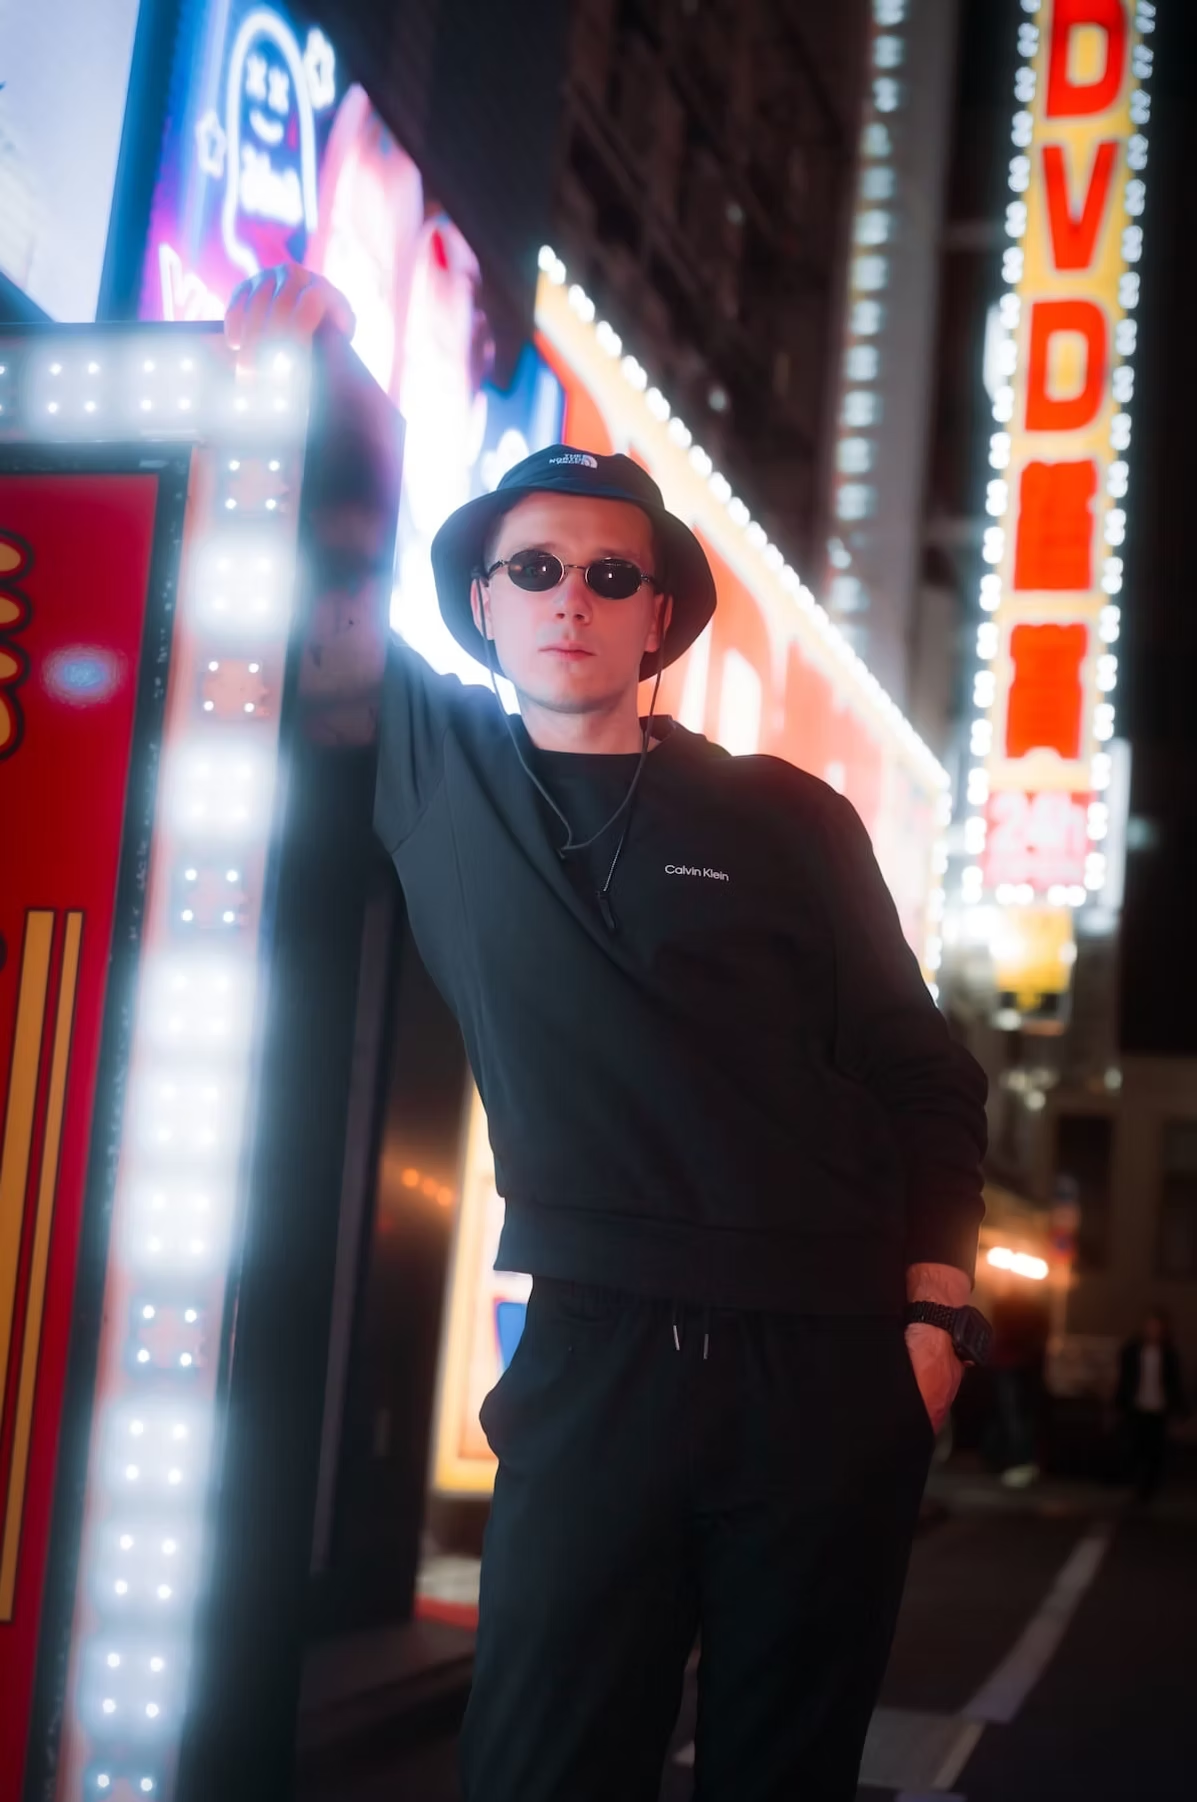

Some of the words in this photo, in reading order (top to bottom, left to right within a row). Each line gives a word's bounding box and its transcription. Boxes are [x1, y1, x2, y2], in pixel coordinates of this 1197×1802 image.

[1024, 0, 1127, 432] DVD
[664, 864, 702, 877] Calvin
[703, 867, 729, 881] Klein
